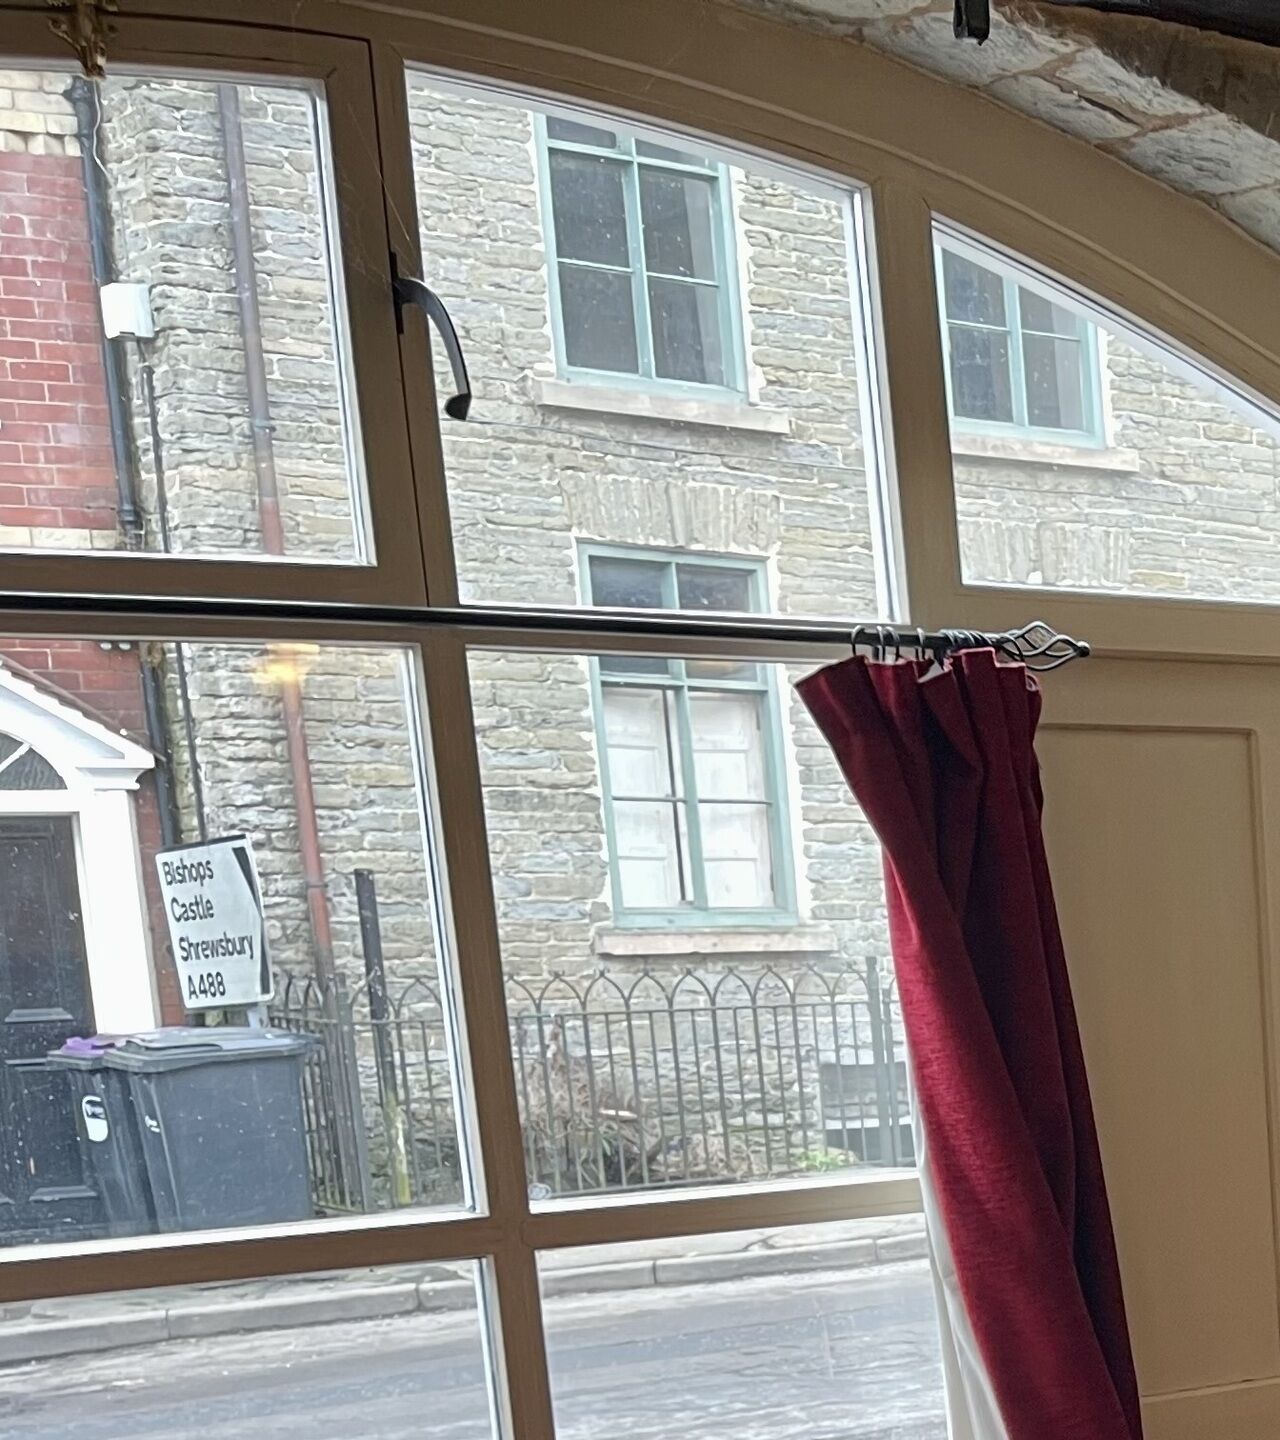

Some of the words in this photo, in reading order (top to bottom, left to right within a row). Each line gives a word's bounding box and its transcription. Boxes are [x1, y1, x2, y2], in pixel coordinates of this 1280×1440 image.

[162, 857, 214, 887] Bishops
[171, 894, 215, 923] Castle
[179, 931, 254, 961] Shrewsbury
[187, 971, 227, 1000] A488
